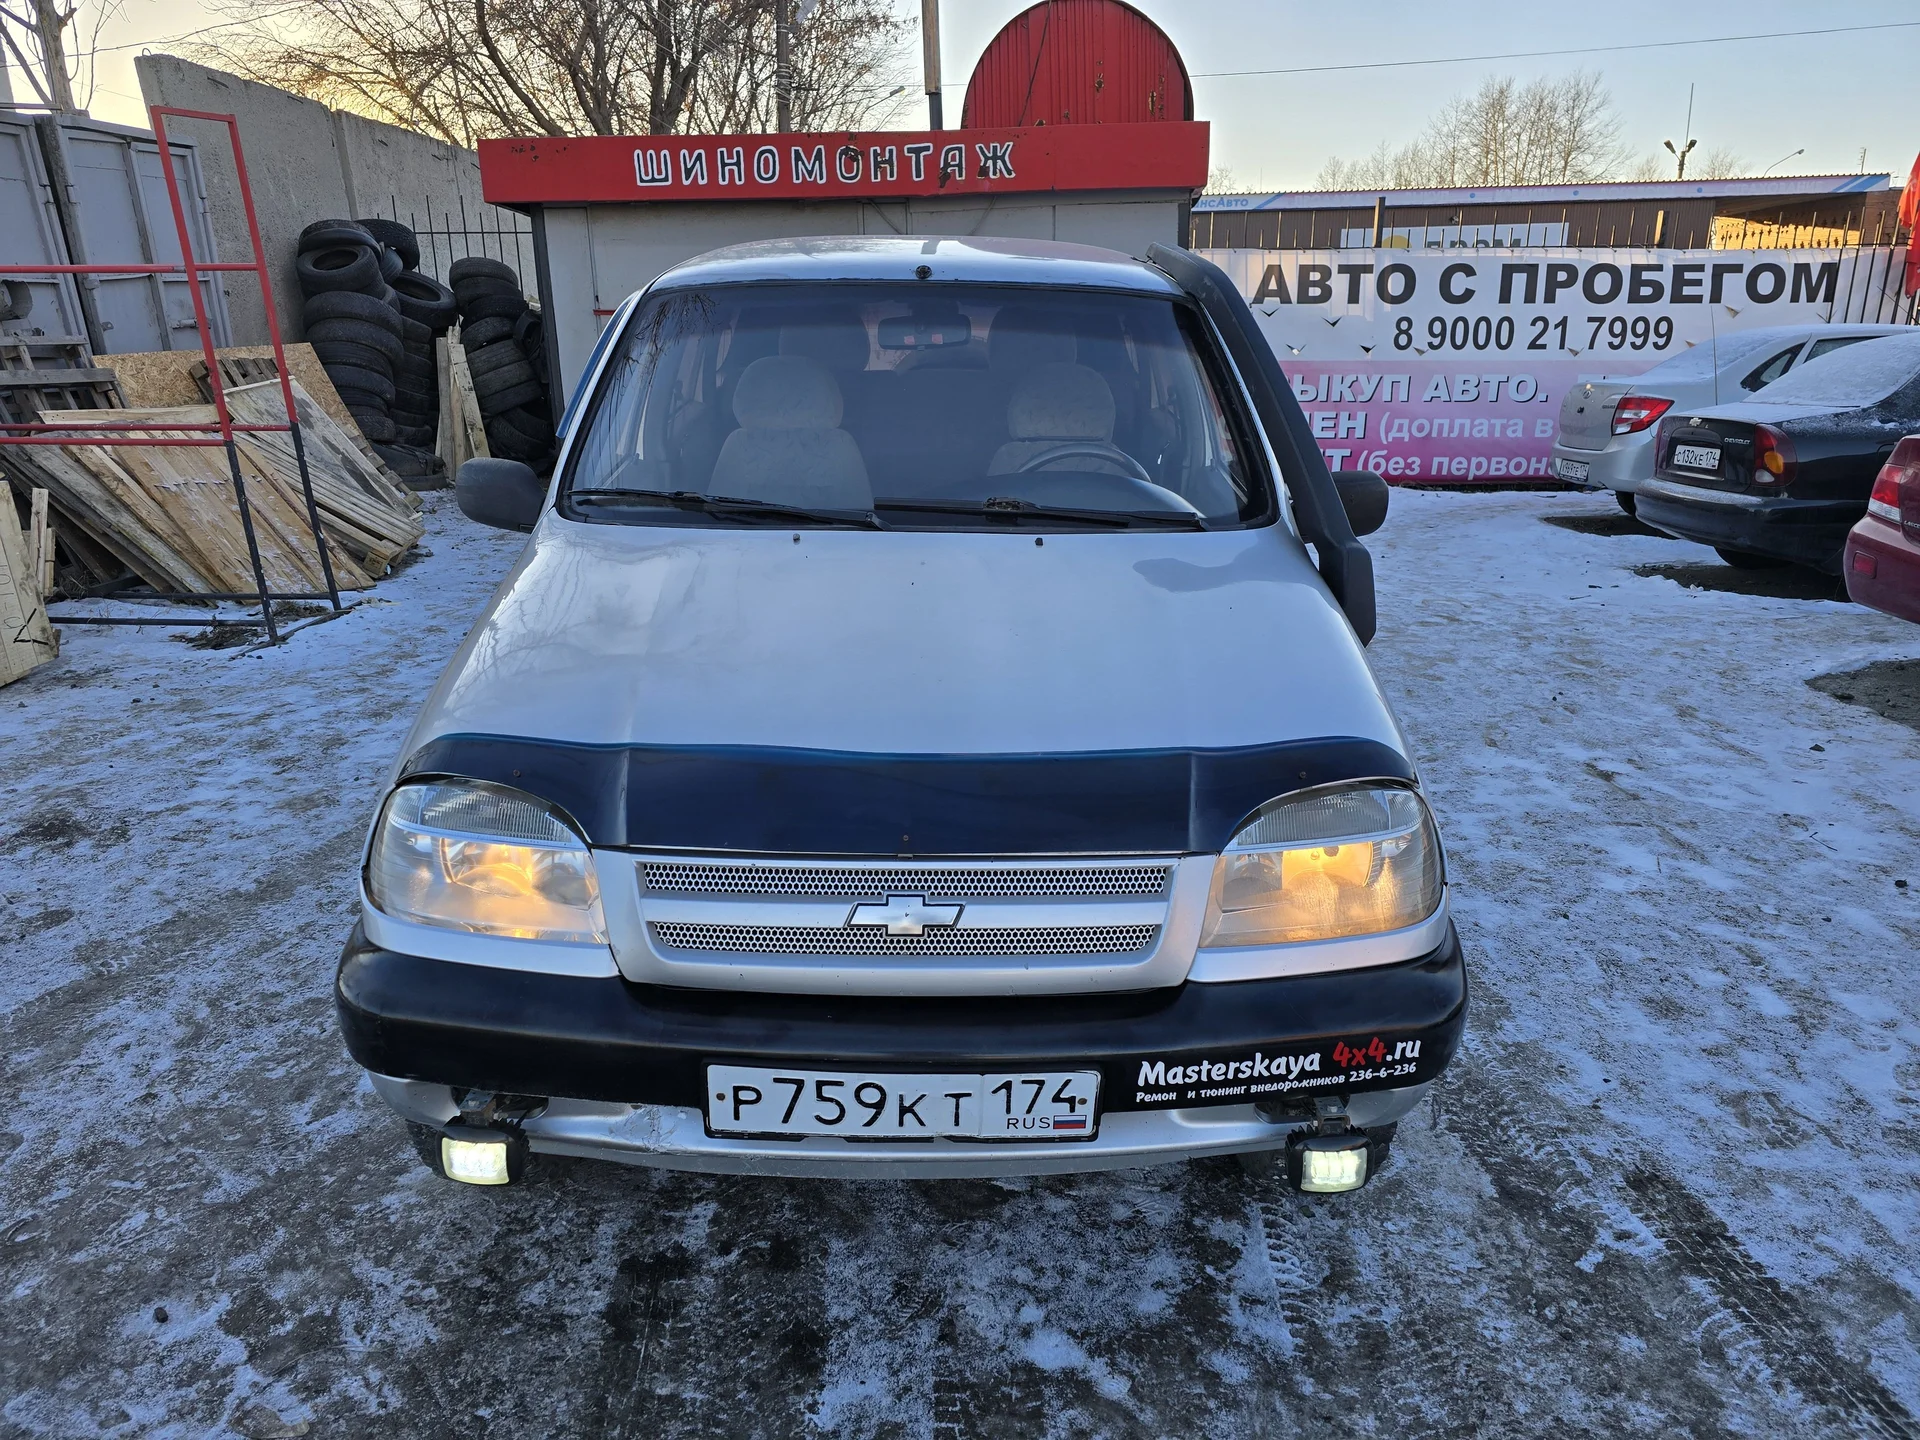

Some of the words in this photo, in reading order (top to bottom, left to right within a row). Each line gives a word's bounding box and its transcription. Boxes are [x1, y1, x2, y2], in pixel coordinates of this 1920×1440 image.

[633, 141, 1017, 188] ШИНОМОНТАЖ
[1251, 262, 1417, 305] АВТО
[1438, 262, 1477, 305] С
[1498, 262, 1839, 305] ПРОБЕГОМ
[1393, 315, 1413, 351] 8
[1427, 315, 1515, 351] 9000
[1527, 315, 1569, 351] 21
[1587, 315, 1674, 351] 7999
[1286, 373, 1411, 403] ЫКУП
[1422, 373, 1548, 403] АВТО.
[1380, 412, 1523, 443] (доплата
[1535, 418, 1553, 437] в
[1357, 449, 1421, 476] (без
[1137, 1052, 1322, 1087] Masterskaya
[1332, 1036, 1422, 1069] 4x4.ru
[1187, 1090, 1195, 1099] и
[1200, 1085, 1247, 1099] тюнинг
[1250, 1074, 1346, 1094] внедорожников
[1349, 1062, 1417, 1083] 236-6-236
[1006, 1116, 1051, 1130] RUS
